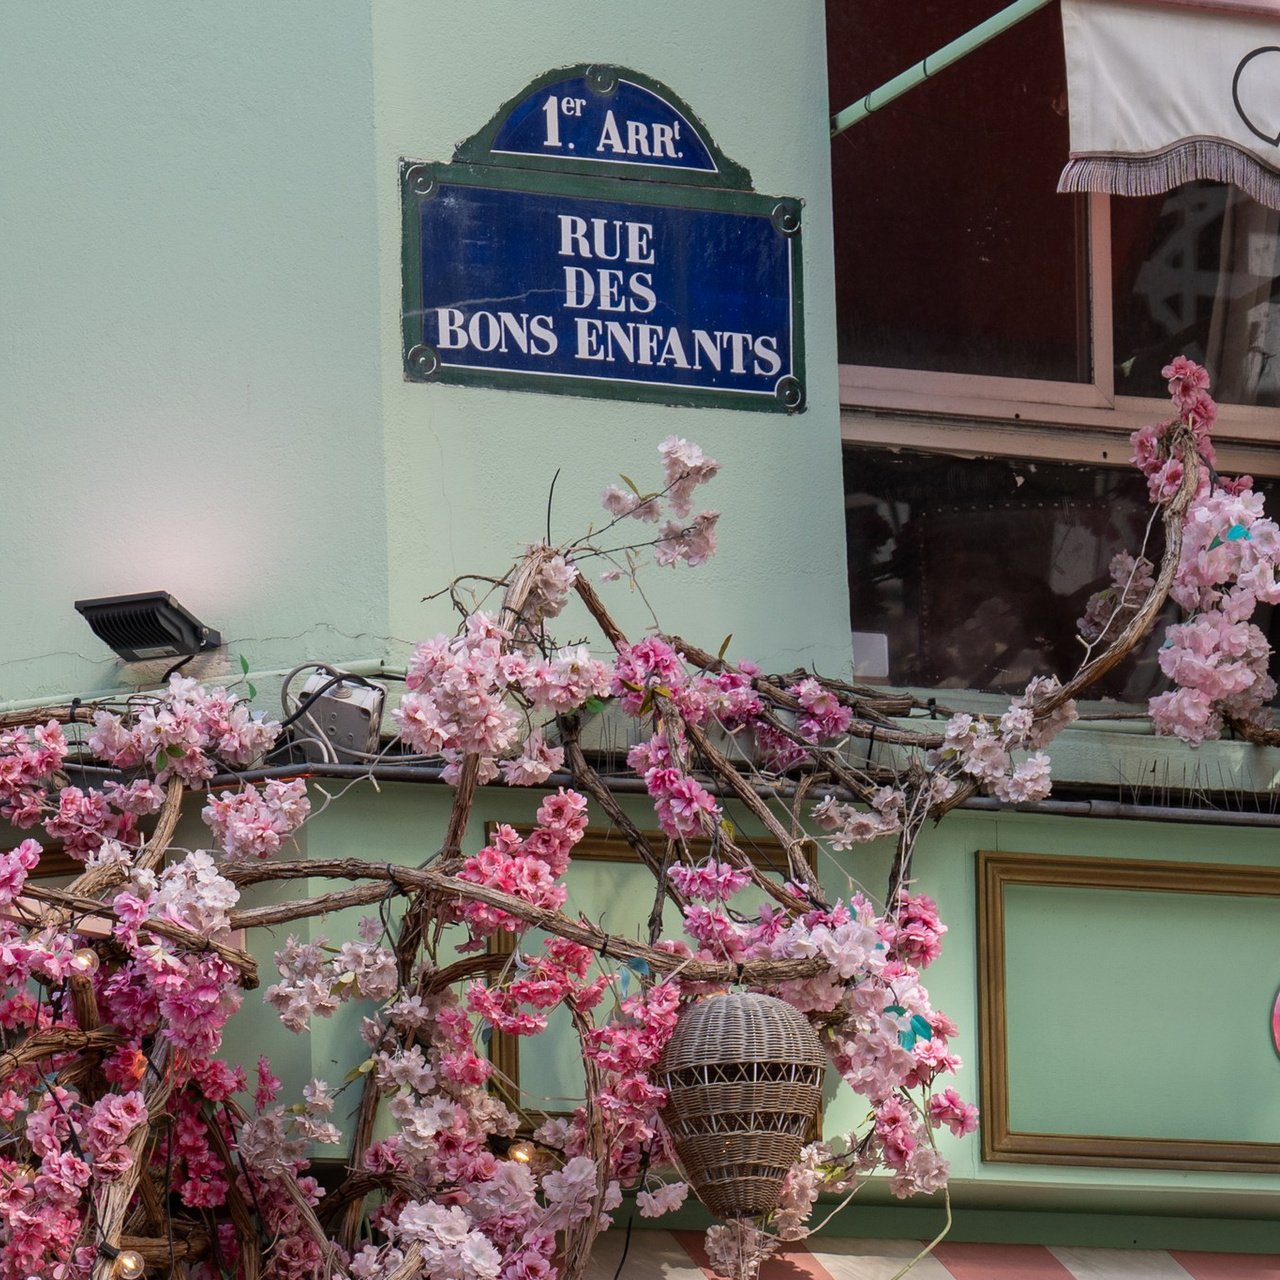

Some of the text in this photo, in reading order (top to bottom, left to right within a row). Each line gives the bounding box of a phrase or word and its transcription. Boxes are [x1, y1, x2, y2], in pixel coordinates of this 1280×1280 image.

[558, 215, 656, 265] RUE
[563, 266, 657, 313] DES
[437, 308, 782, 376] BONS ENFANTS
